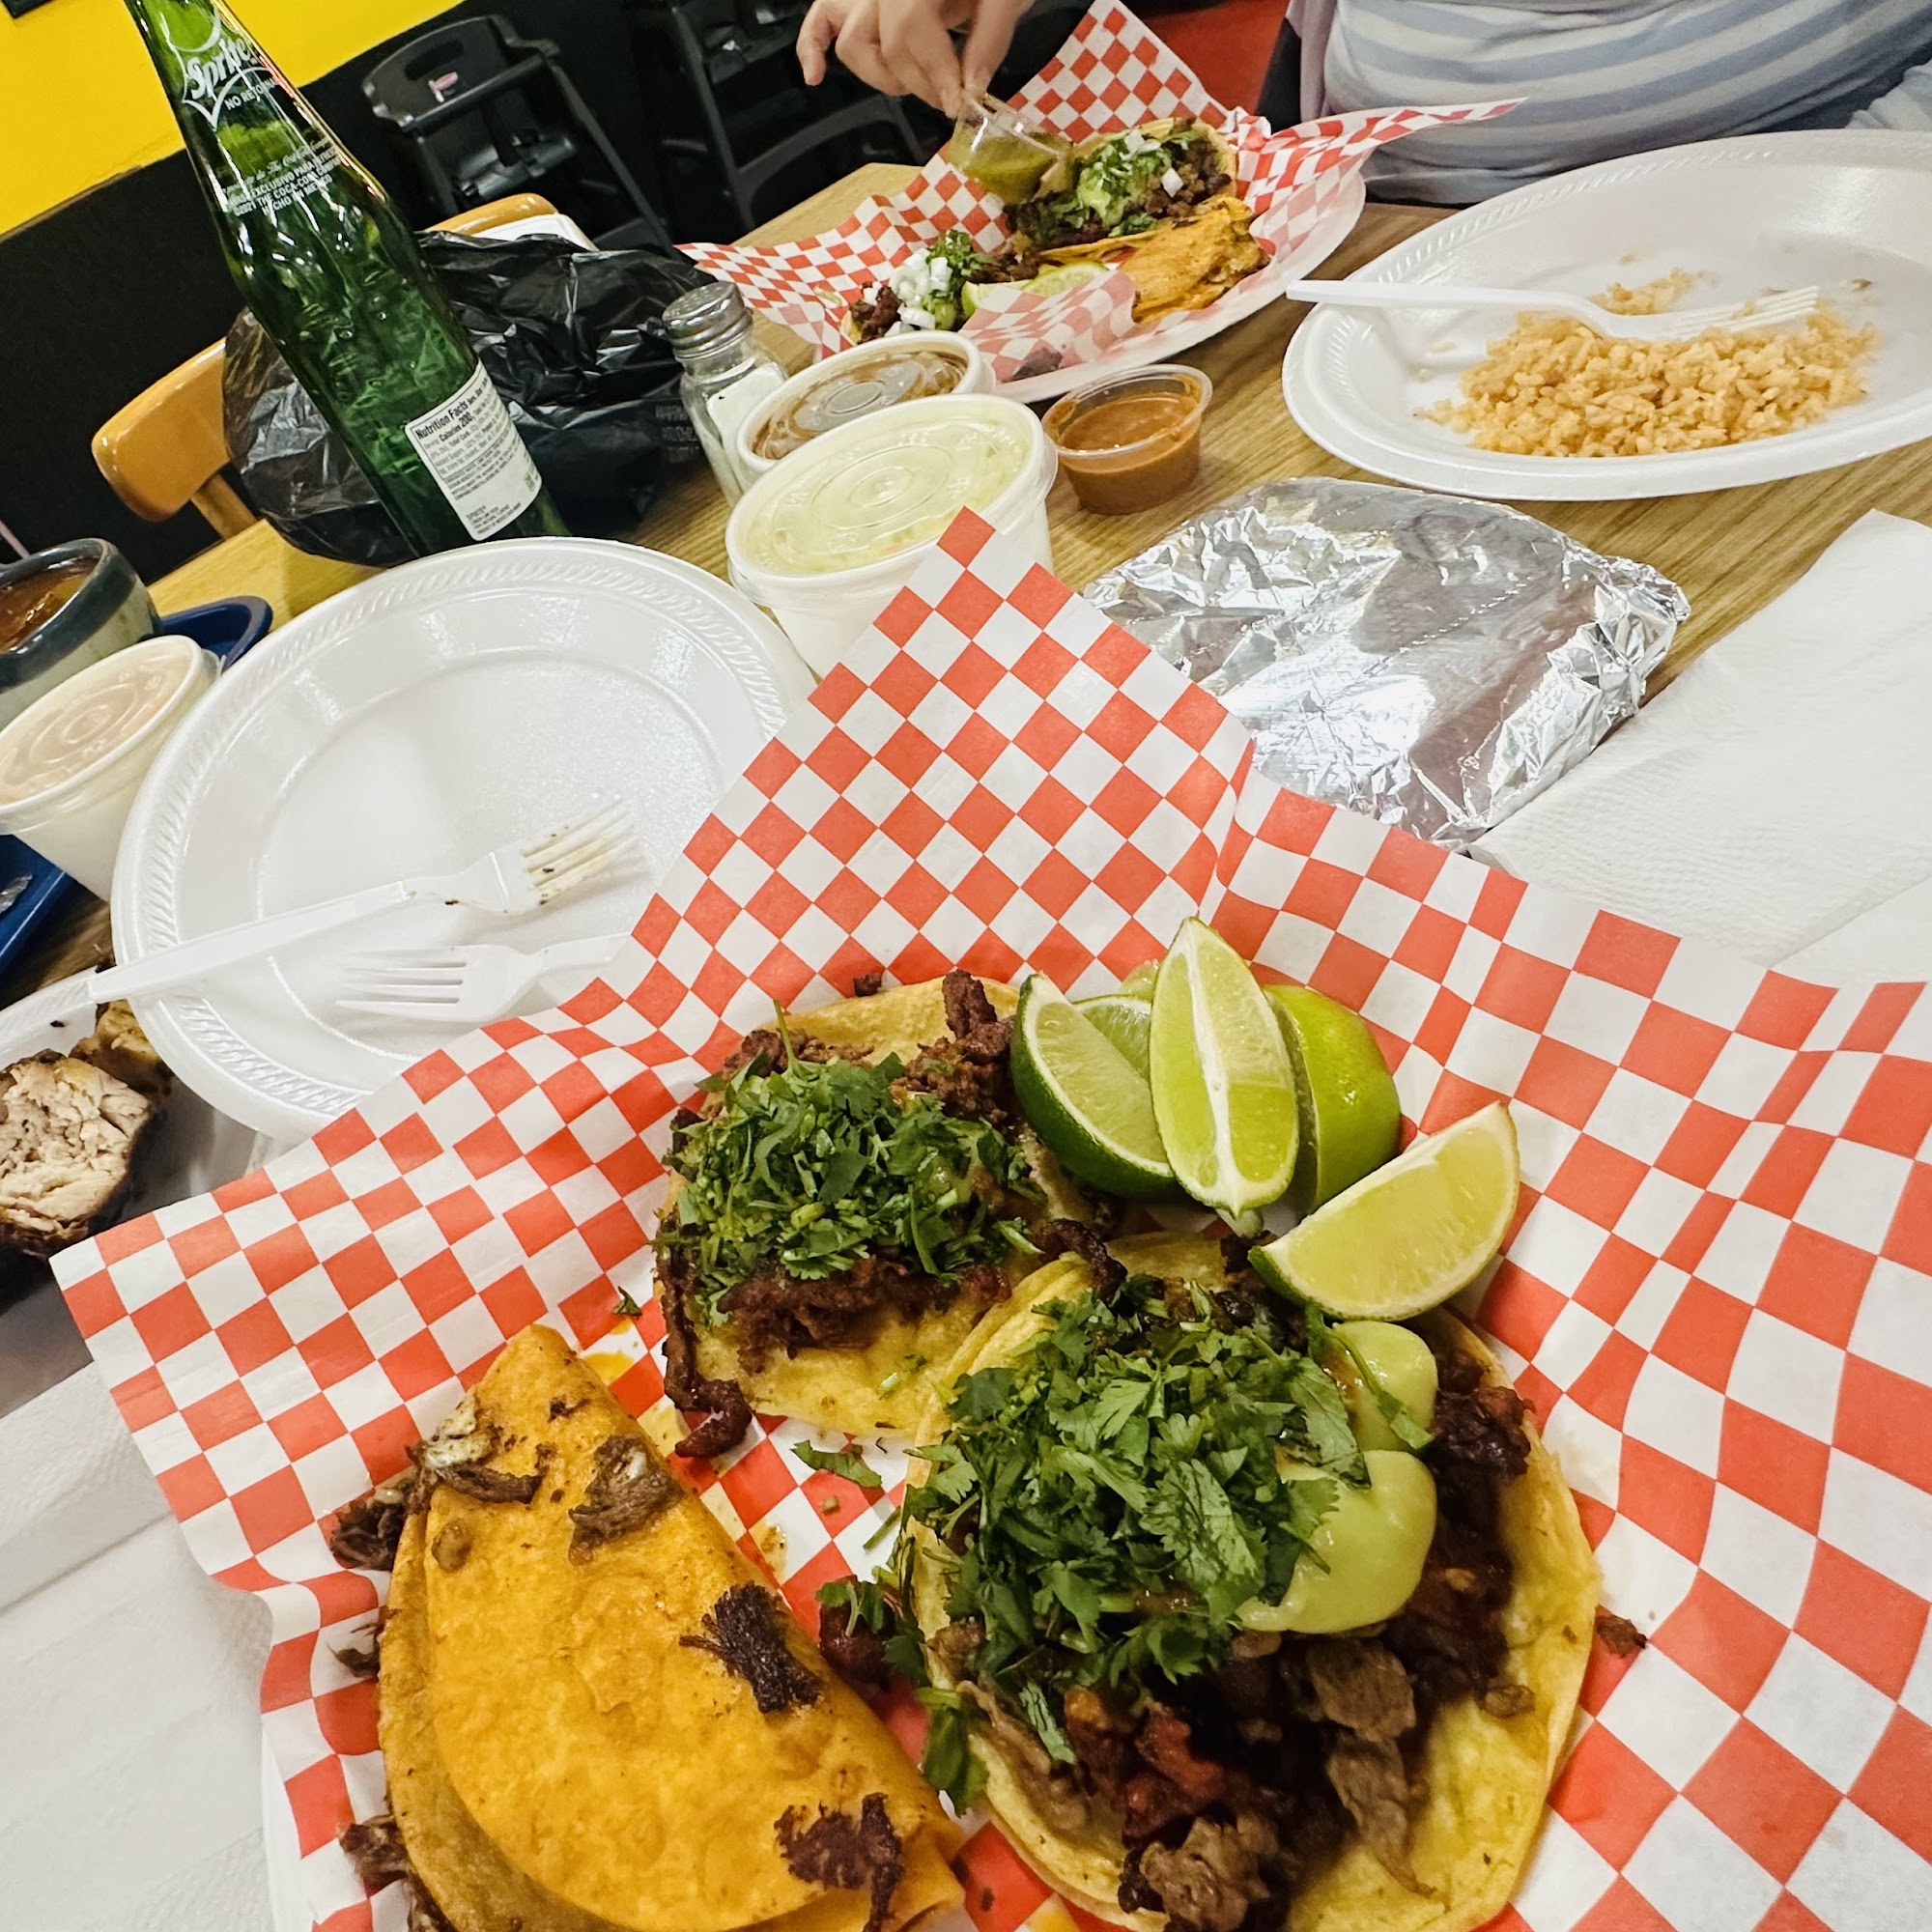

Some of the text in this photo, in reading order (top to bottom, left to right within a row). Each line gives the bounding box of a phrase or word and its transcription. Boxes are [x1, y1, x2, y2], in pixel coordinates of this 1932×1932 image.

[186, 38, 252, 99] Sprite
[225, 96, 242, 110] NO
[251, 172, 295, 198] EXCLUSIVO
[294, 161, 314, 177] PARA
[257, 193, 273, 207] THE
[415, 414, 450, 440] Nutrition
[447, 401, 469, 419] Facts
[439, 425, 462, 441] Calories
